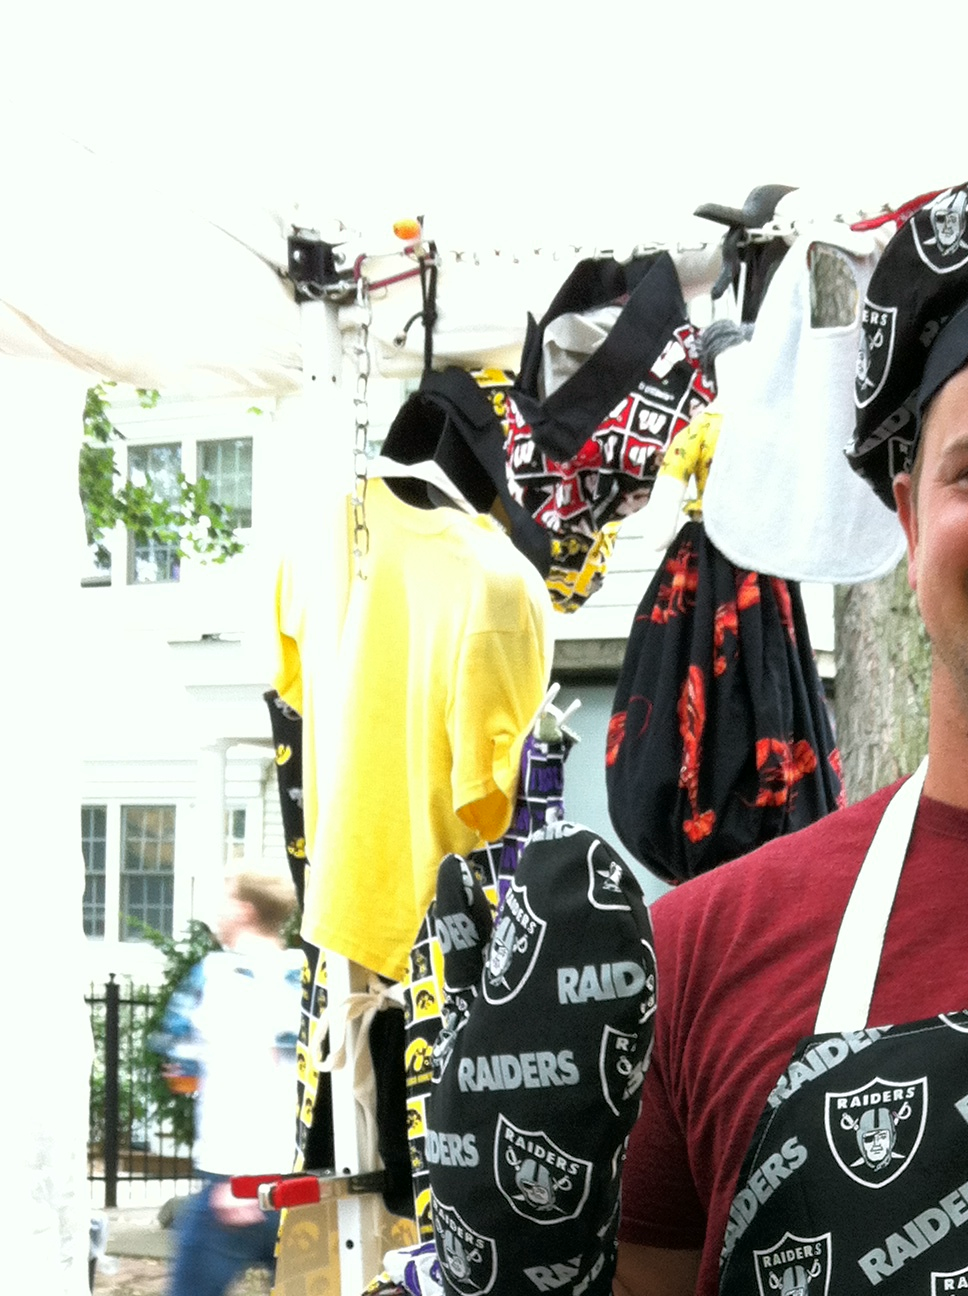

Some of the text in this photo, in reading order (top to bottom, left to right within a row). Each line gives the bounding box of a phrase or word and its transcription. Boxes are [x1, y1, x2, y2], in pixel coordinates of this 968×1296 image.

[457, 1050, 580, 1094] RAIDERS
[837, 1085, 916, 1110] RAIDERS
[504, 1126, 580, 1177] RAIDERS
[763, 1241, 823, 1268] RAIDERS
